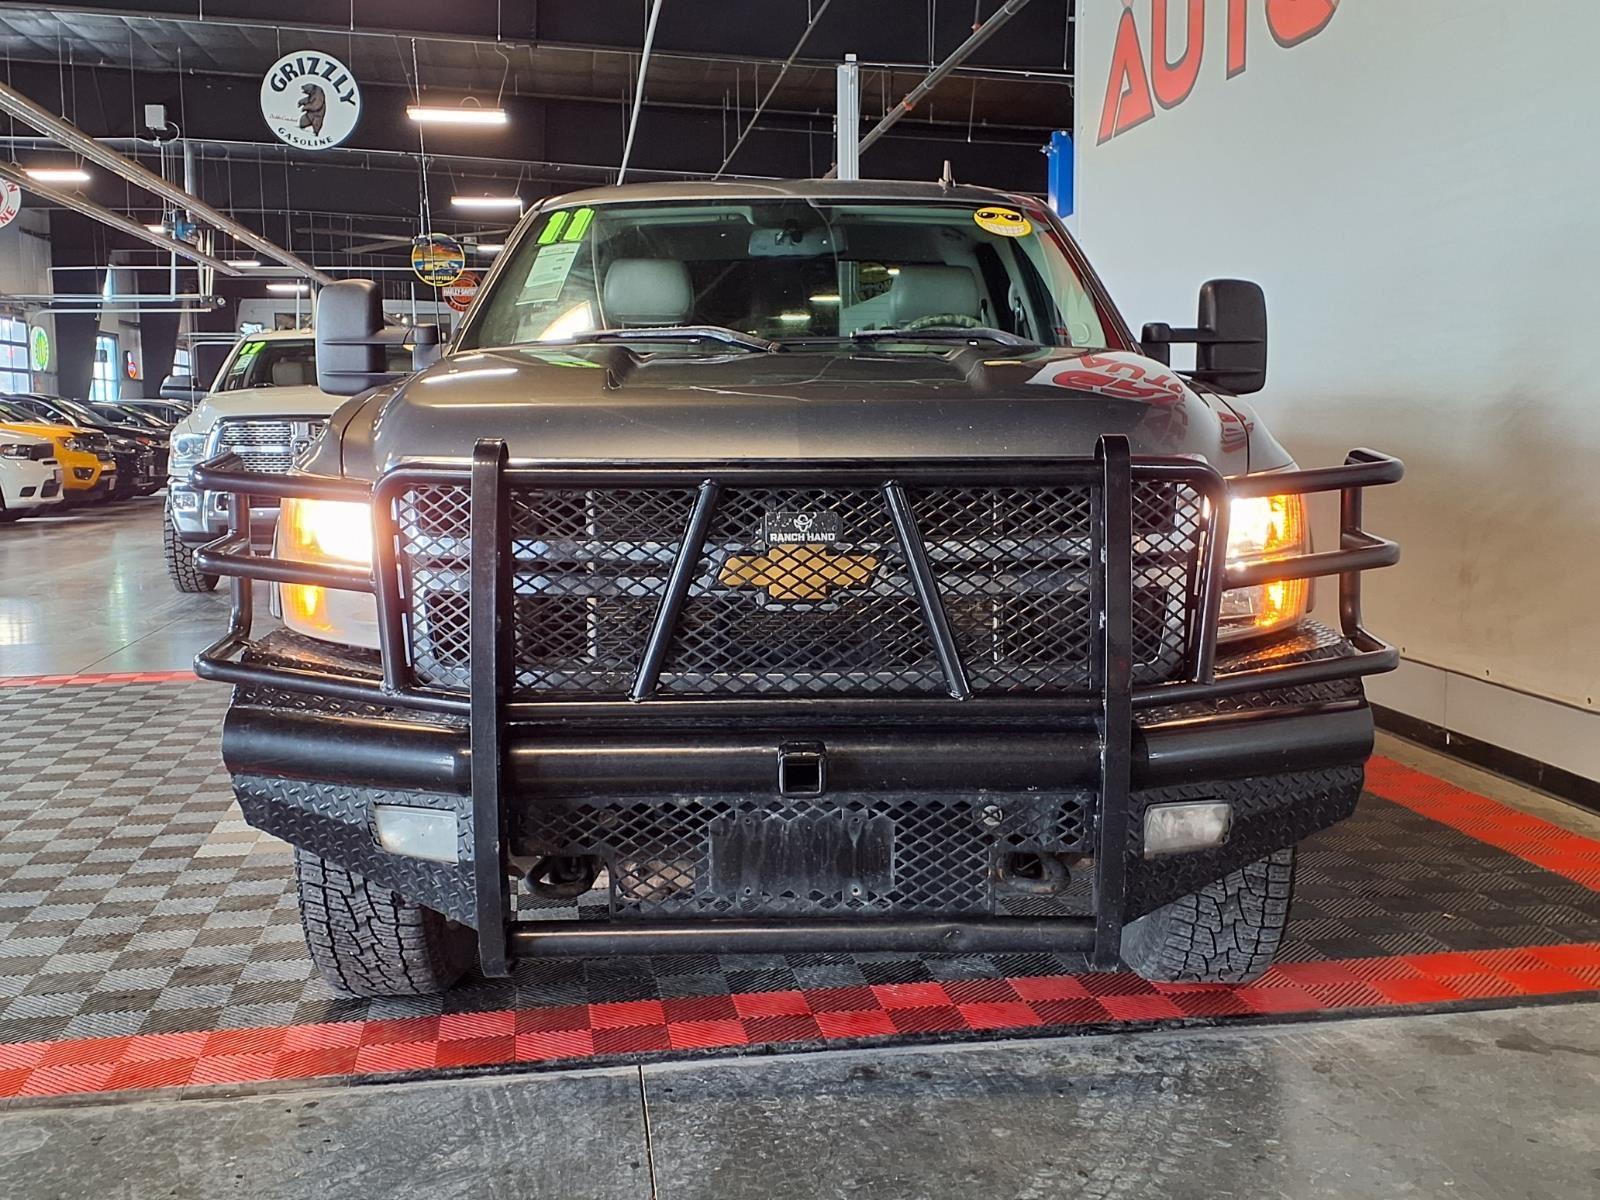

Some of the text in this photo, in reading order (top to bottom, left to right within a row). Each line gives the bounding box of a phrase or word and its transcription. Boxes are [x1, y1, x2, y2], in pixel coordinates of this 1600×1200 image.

[270, 57, 356, 106] GRIZZLY
[278, 127, 334, 147] GASOLINE
[537, 207, 595, 245] 11
[769, 532, 836, 542] RANCH HAND
